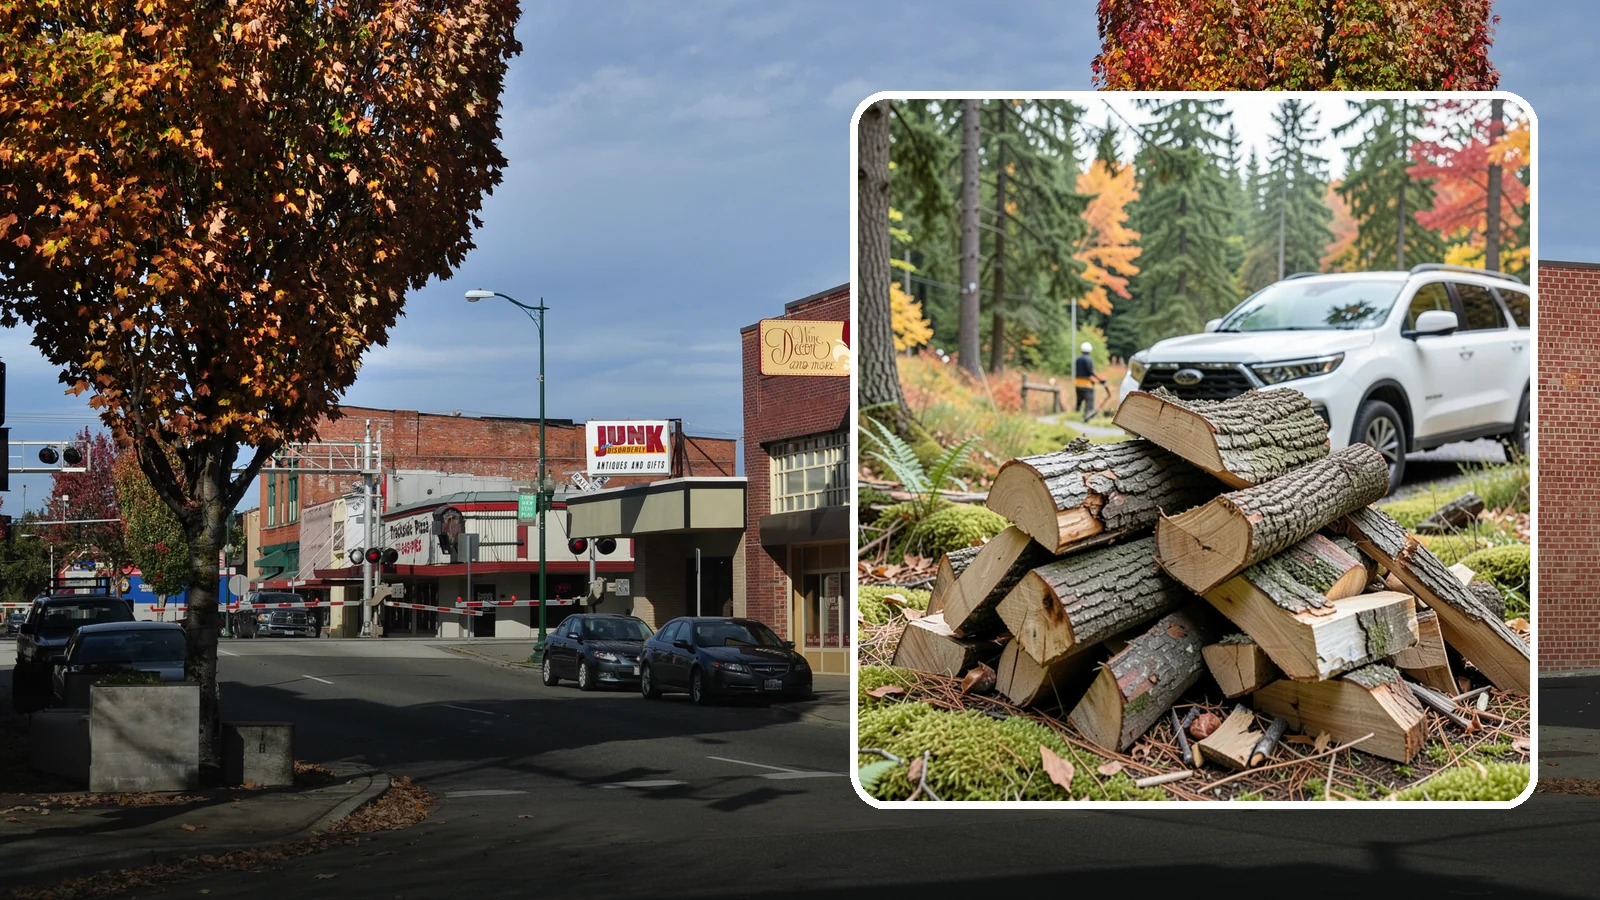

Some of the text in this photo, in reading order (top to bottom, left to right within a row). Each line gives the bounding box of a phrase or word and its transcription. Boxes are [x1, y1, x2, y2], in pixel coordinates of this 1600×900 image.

[765, 328, 831, 365] Decor
[596, 425, 665, 457] JUNK
[608, 446, 645, 454] DISORDERLY
[597, 460, 665, 470] ANTIQUES AND GIFTS
[414, 519, 429, 535] Pizza
